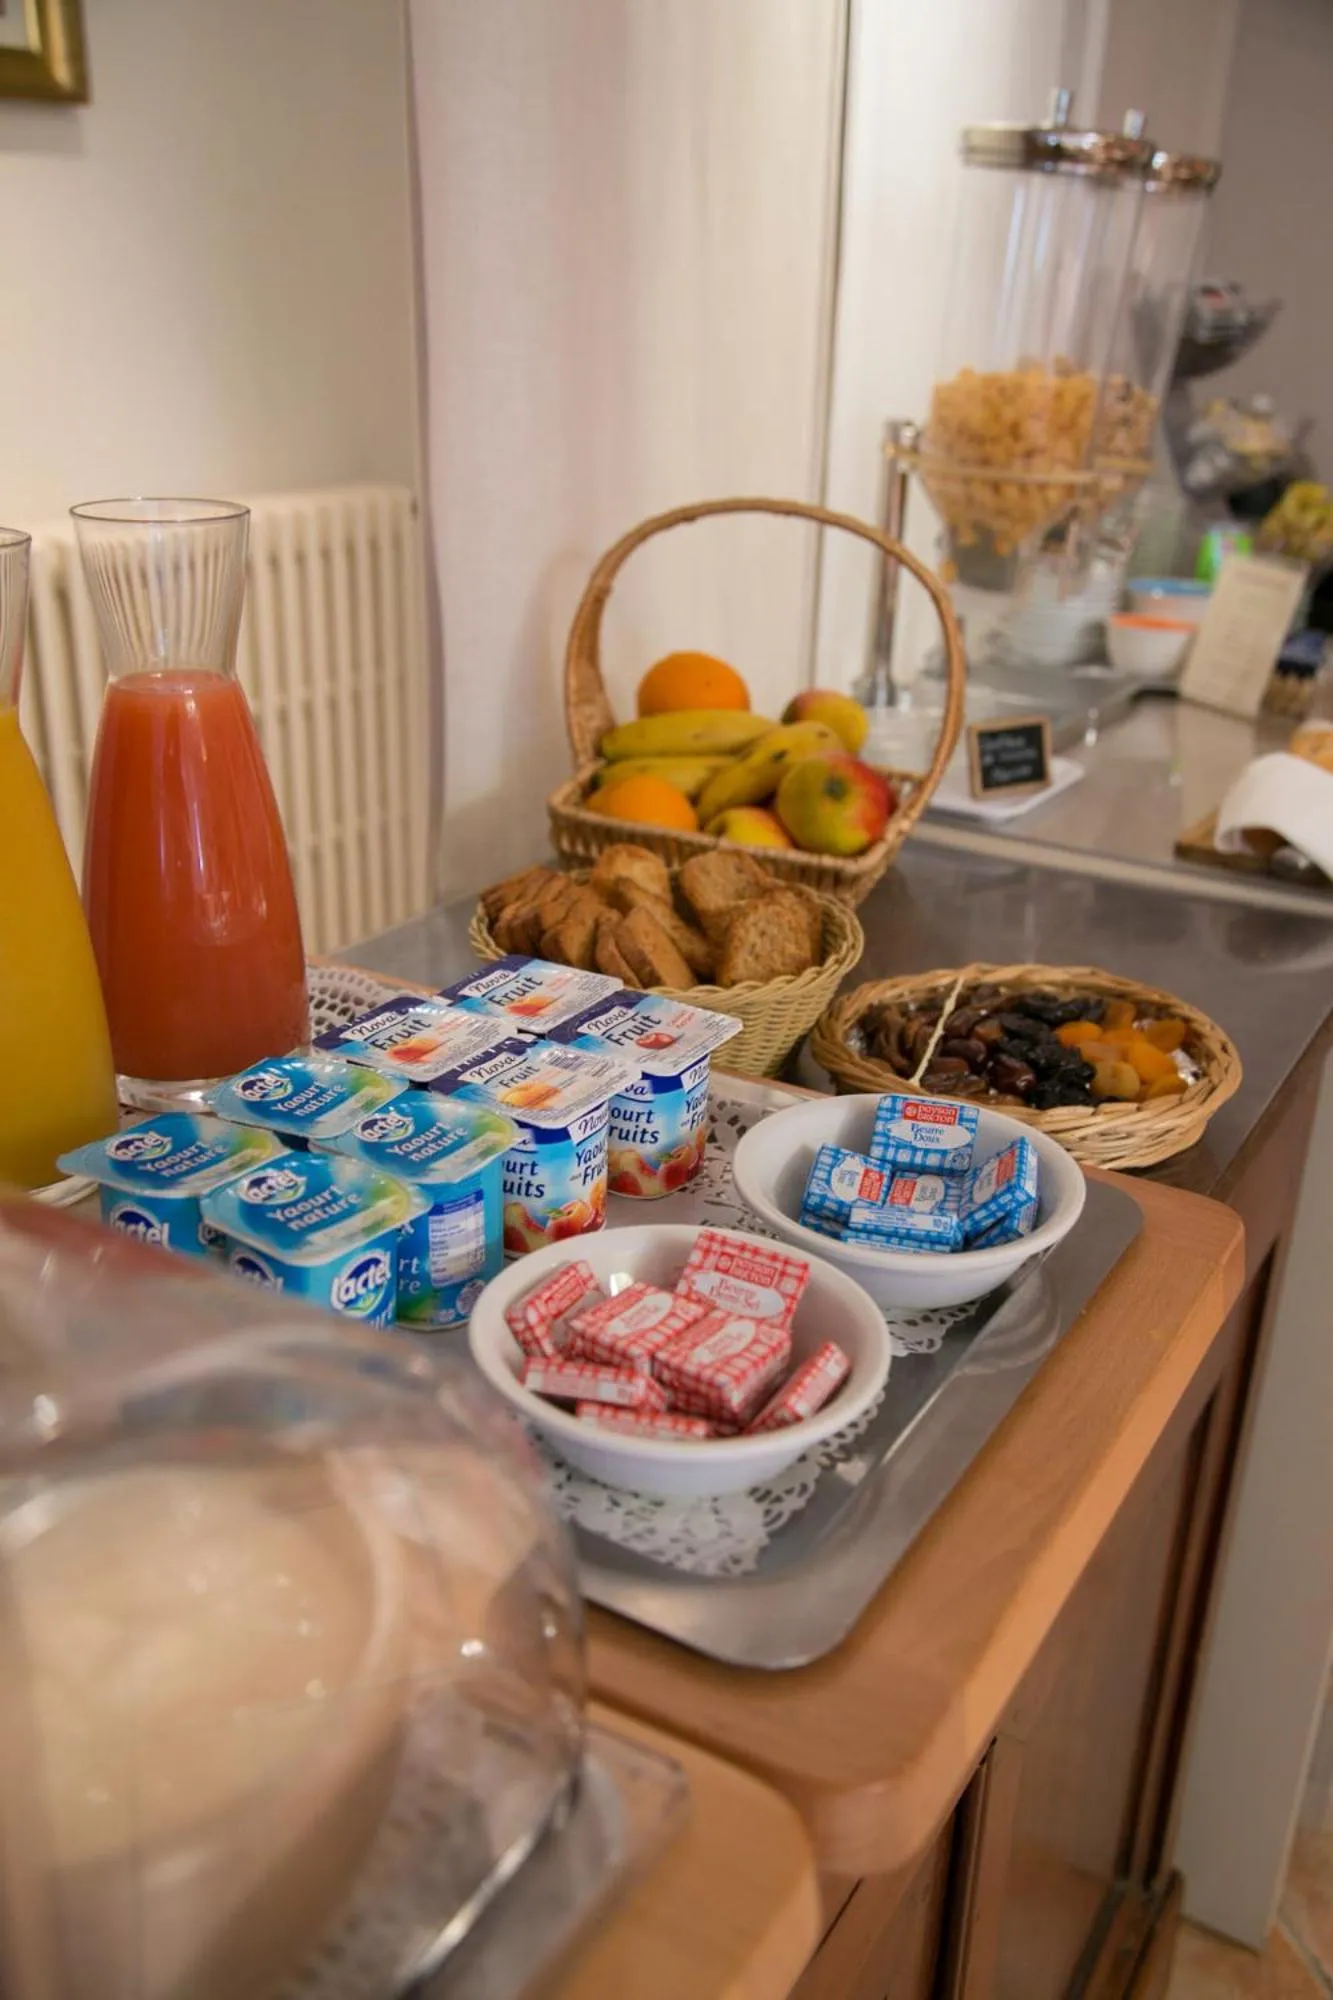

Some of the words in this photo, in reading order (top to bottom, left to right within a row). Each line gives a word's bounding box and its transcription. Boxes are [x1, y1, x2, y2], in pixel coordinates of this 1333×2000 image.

[468, 973, 511, 993] Nova
[488, 975, 543, 1007] Fruit
[351, 1014, 396, 1036] Nova
[369, 1019, 431, 1051] Fruit
[586, 1008, 628, 1032] Nova
[606, 1014, 661, 1046] Fruit
[469, 1055, 516, 1079] Nova
[499, 1065, 540, 1088] Fruit
[271, 1080, 327, 1112] Yaourt
[293, 1084, 347, 1116] nature
[610, 1107, 655, 1124] ourt
[386, 1120, 451, 1156] Yaourt
[409, 1127, 468, 1162] nature
[608, 1125, 659, 1144] ruits
[137, 1141, 211, 1172] Yaourt
[502, 1159, 538, 1176] urt
[265, 1184, 345, 1222] Yaourt
[502, 1177, 545, 1198] uits
[288, 1193, 361, 1231] nature
[330, 1251, 392, 1310] lactel
